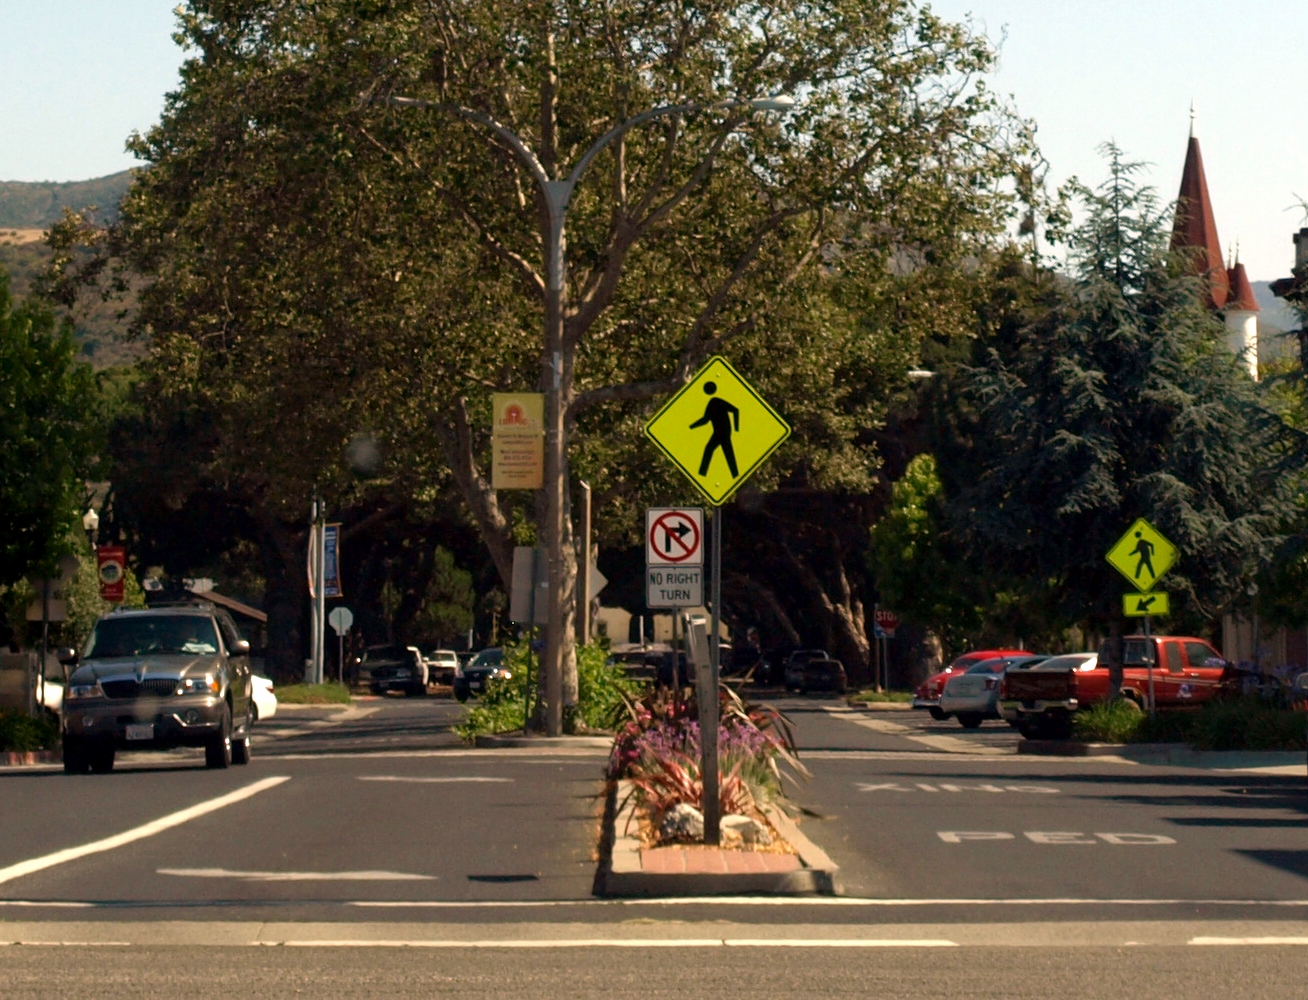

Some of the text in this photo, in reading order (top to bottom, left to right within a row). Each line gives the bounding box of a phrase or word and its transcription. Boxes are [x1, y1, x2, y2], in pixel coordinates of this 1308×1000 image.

[650, 572, 700, 586] NO RIGHT
[660, 589, 691, 601] TURN
[852, 782, 1061, 793] XING
[936, 831, 1177, 845] PED
